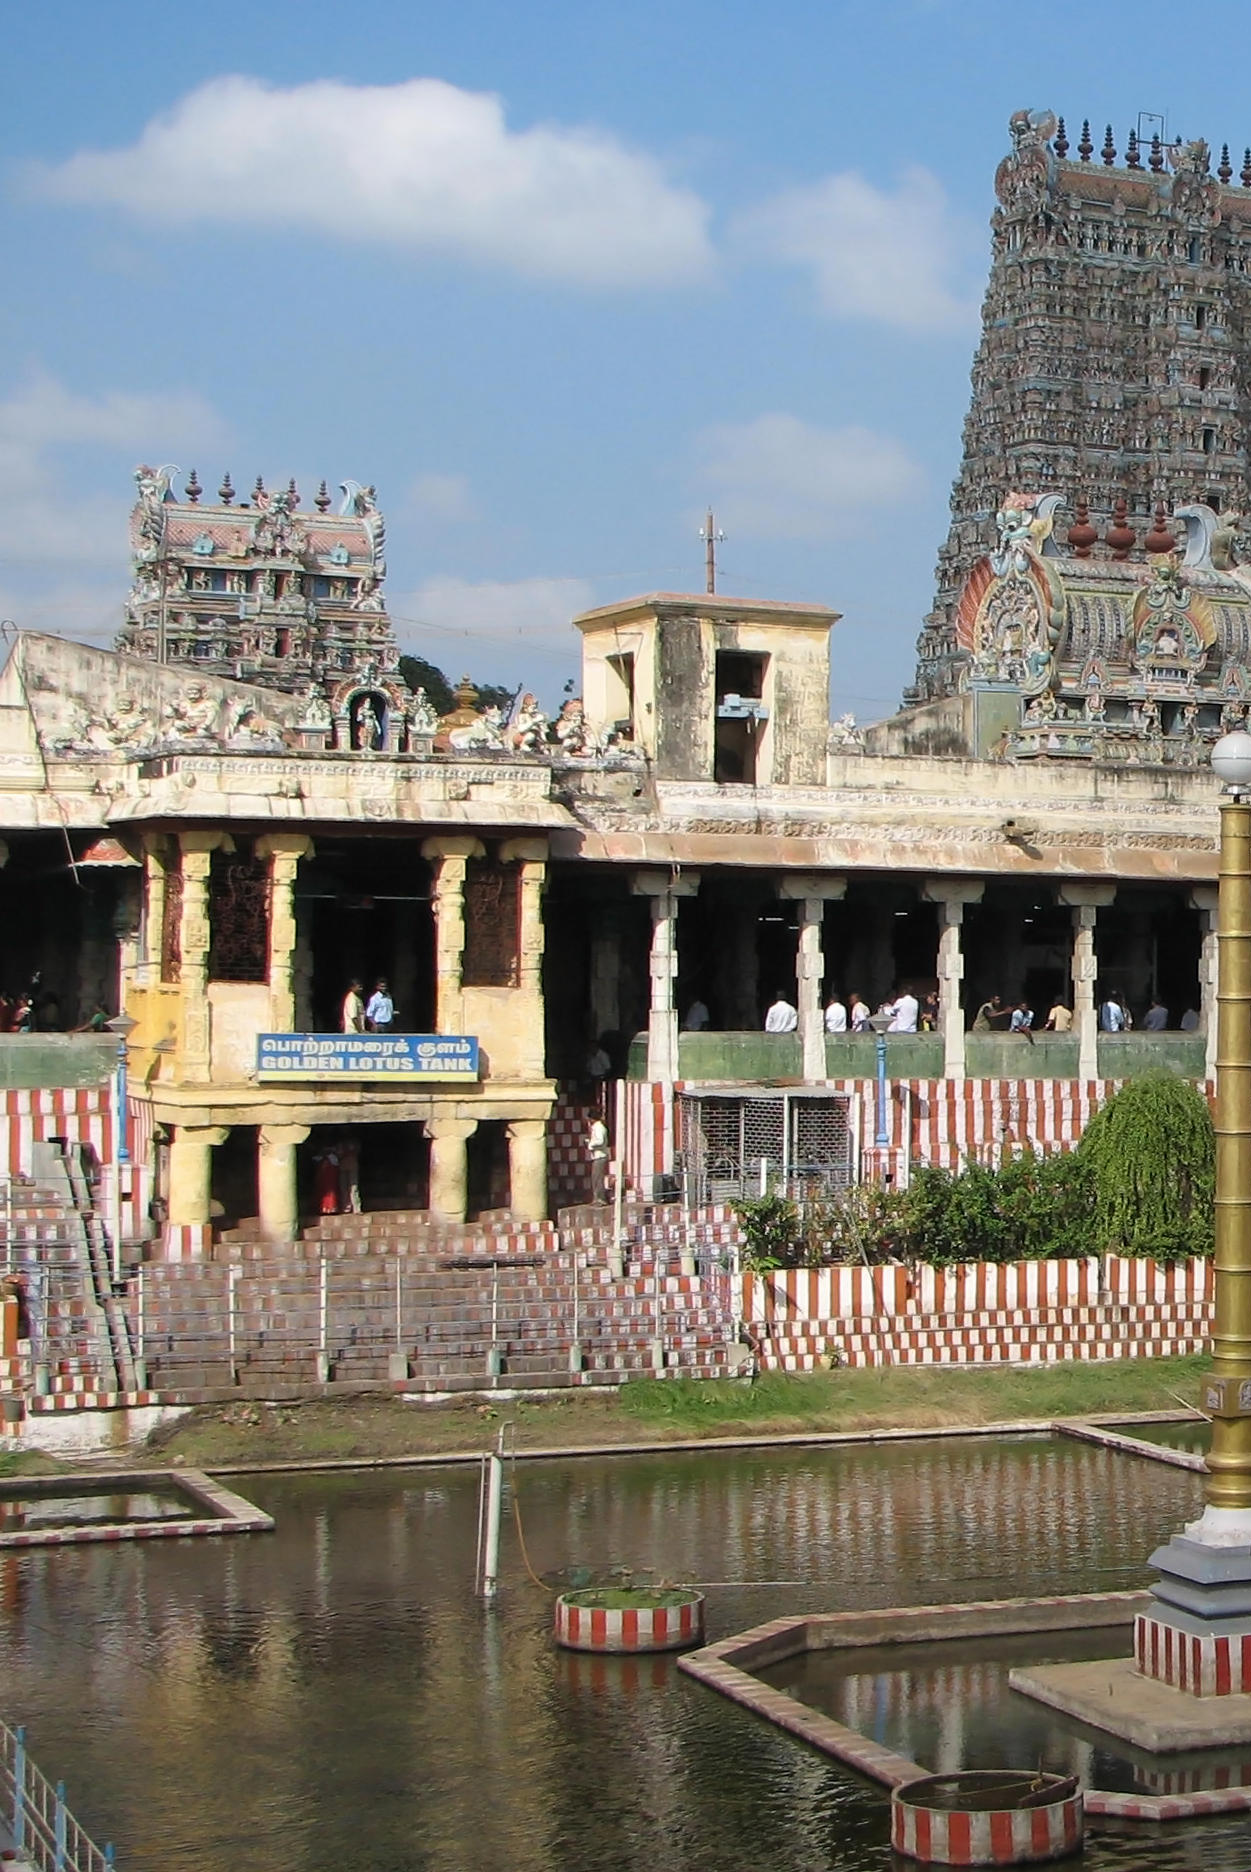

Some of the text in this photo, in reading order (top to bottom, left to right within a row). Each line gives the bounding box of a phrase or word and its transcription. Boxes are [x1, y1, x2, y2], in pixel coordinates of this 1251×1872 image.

[262, 1038, 471, 1057] பொற்றாமரைக் குளம்
[262, 1056, 473, 1071] GOLDEN LOTUS TANK
